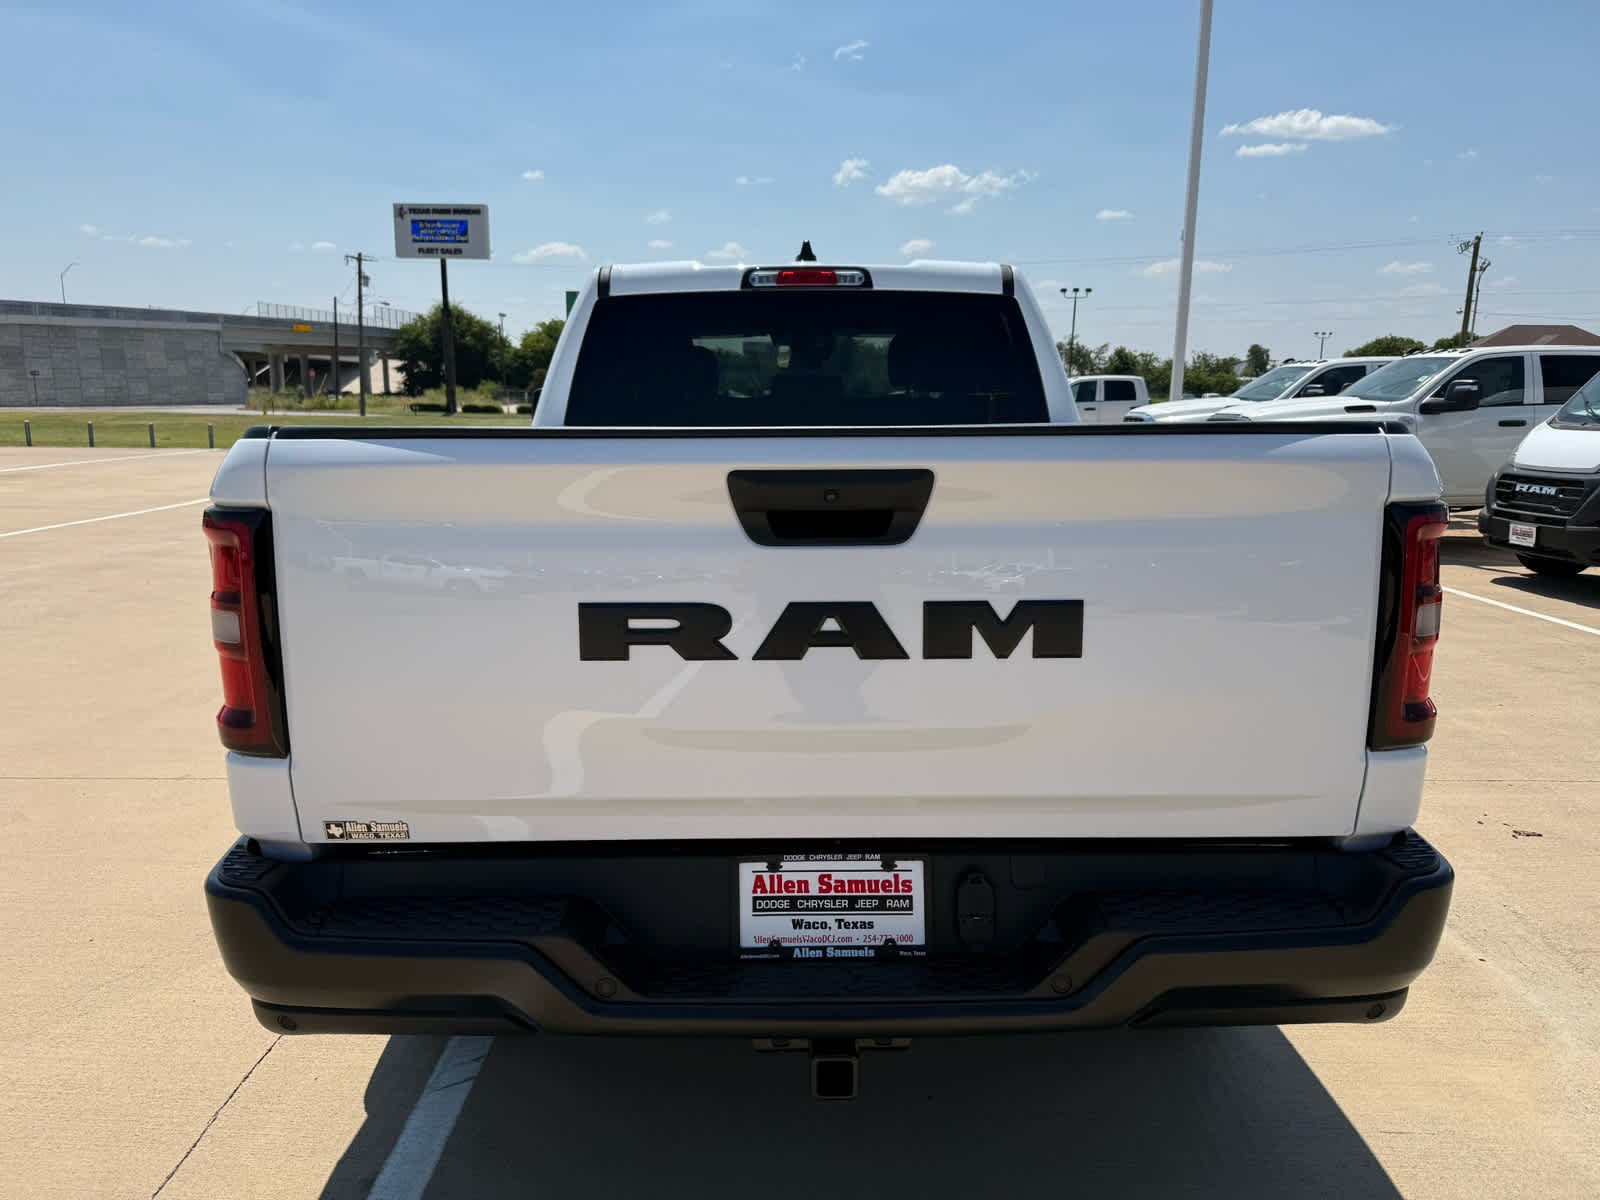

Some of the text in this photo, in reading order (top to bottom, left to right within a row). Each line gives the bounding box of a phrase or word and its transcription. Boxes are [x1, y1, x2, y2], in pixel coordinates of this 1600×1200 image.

[418, 247, 463, 255] FLEET SALES
[1515, 482, 1557, 496] RAM
[578, 599, 1085, 662] RAM
[345, 821, 408, 832] Allen Samuels
[809, 853, 843, 861] CHRYSLER
[752, 873, 913, 895] Allen Samuels
[756, 899, 910, 909] DODGE CHRYSLER JEEP RAM
[791, 918, 875, 931] Waco, Texas
[793, 947, 824, 959] Allen
[826, 947, 875, 958] Samuels
